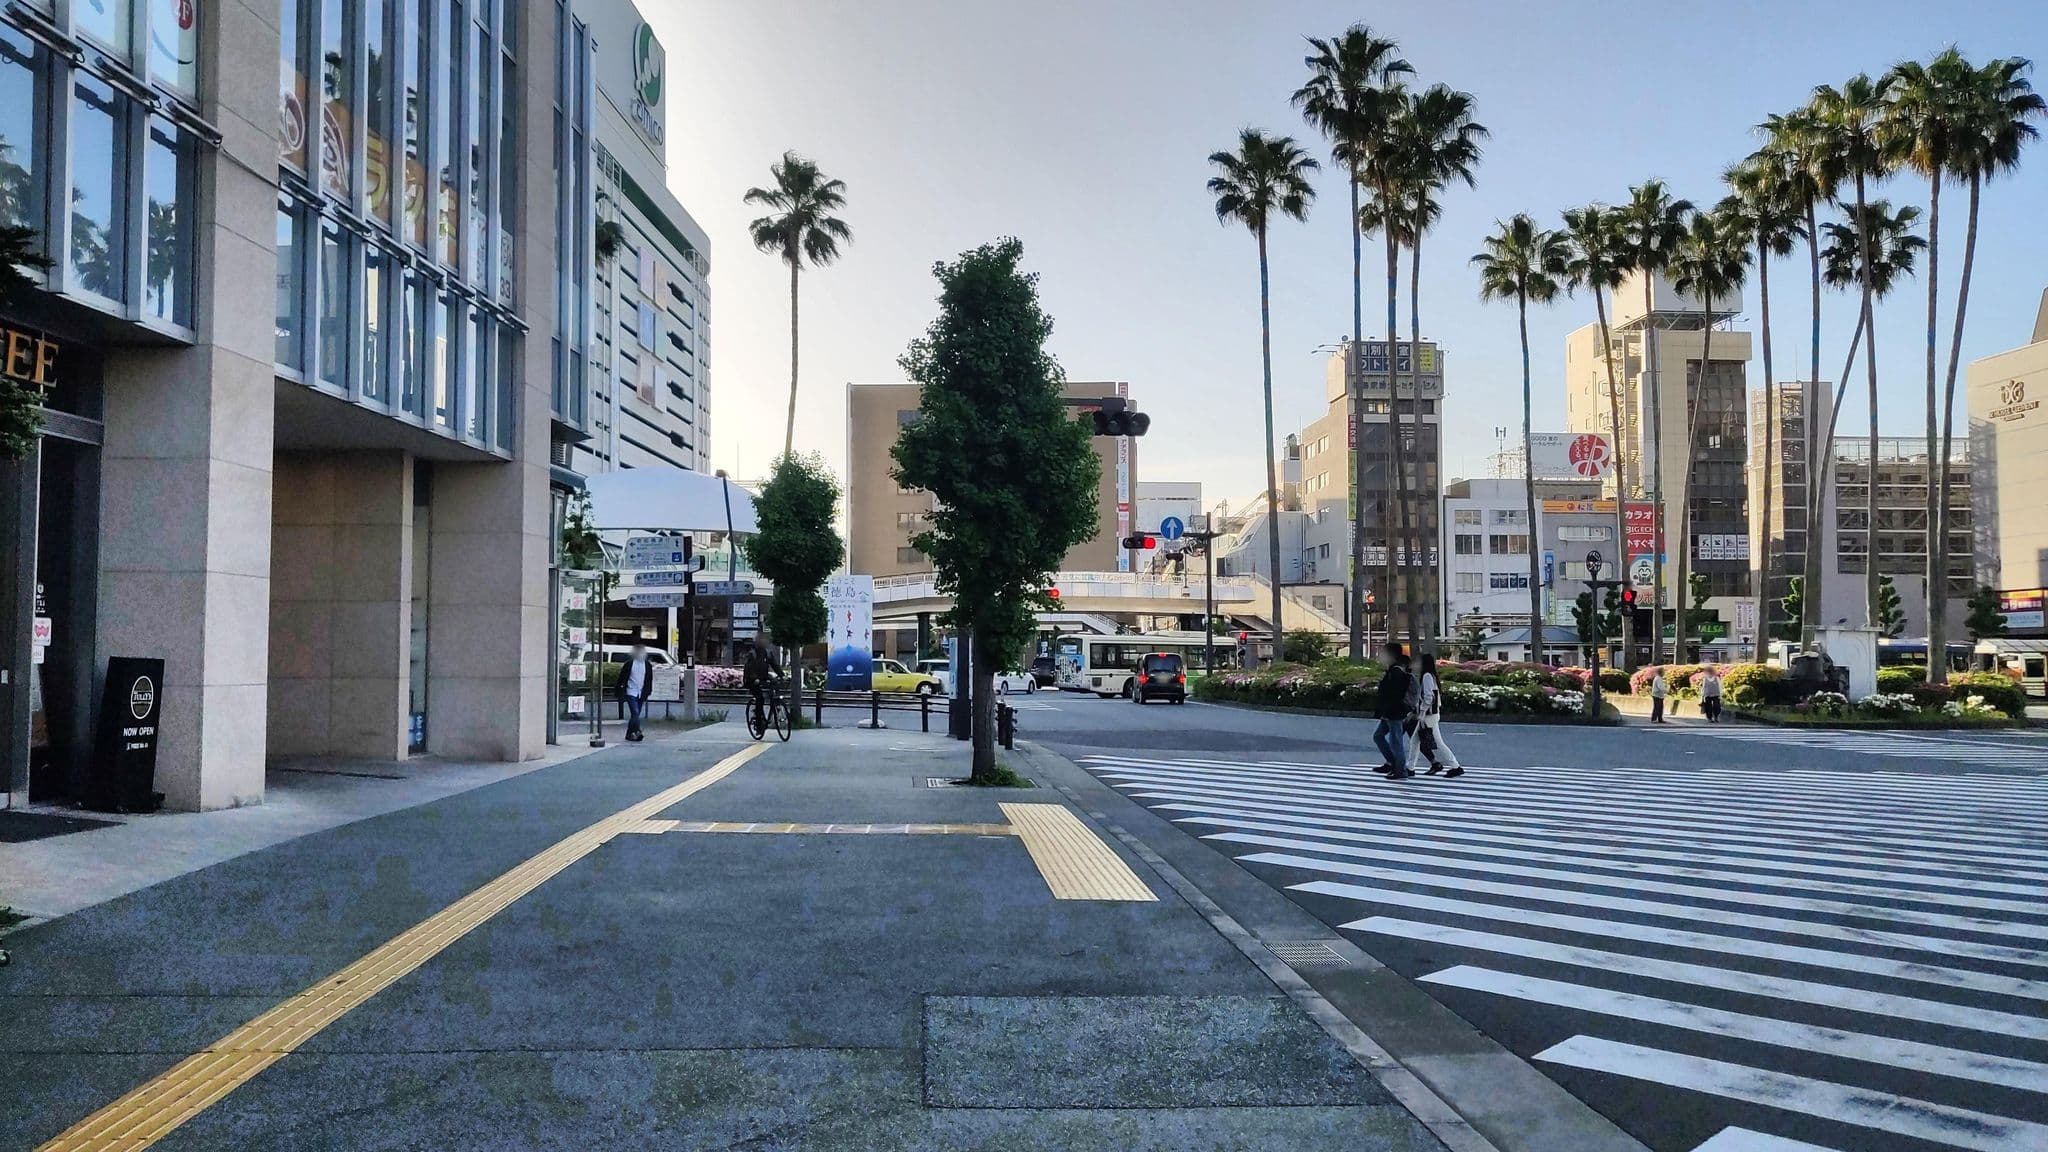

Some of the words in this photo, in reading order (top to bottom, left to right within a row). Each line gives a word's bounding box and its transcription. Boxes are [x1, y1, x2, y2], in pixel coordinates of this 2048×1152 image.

[0, 328, 59, 388] EE
[1624, 510, 1662, 520] カラオ
[123, 727, 138, 737] NOW
[138, 727, 155, 736] OPEN
